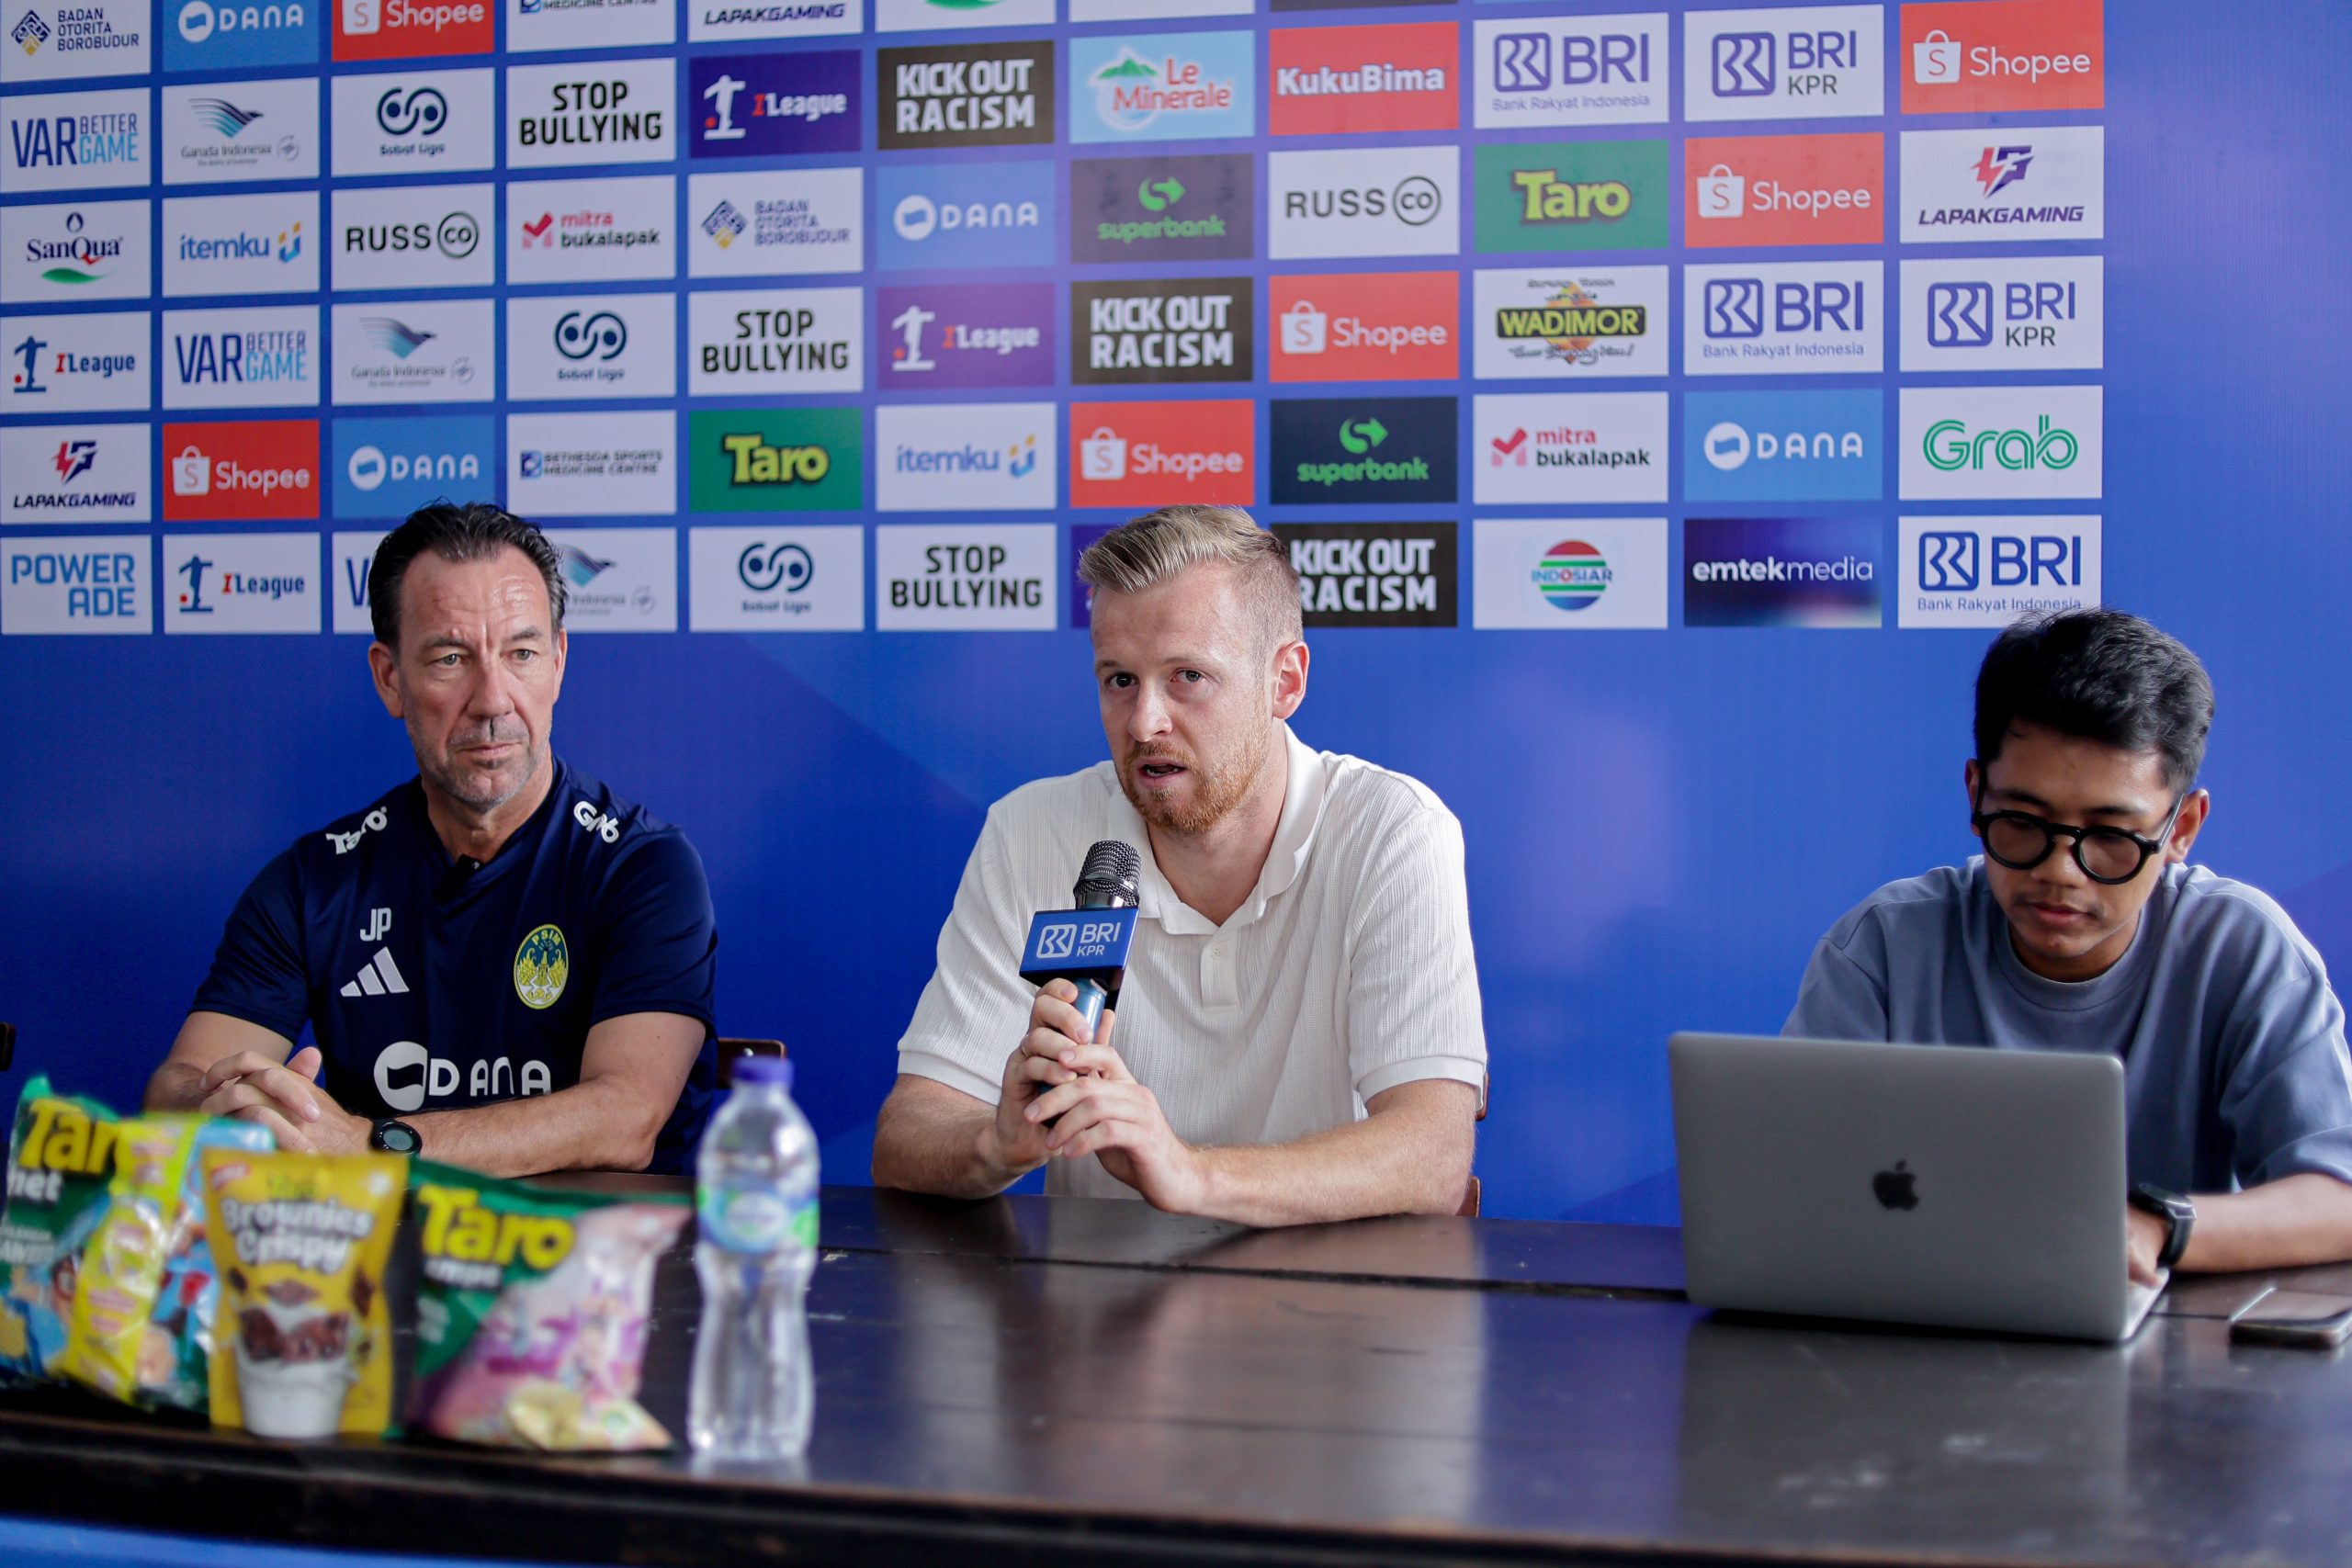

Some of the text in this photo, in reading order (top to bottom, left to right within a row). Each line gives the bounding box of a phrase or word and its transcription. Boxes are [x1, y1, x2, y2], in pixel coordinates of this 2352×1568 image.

[58, 7, 104, 24] BADAN
[58, 21, 112, 36] OTORITA
[219, 5, 304, 32] DANA
[387, 0, 485, 32] Shopee
[705, 4, 844, 26] LAPAKGAMING
[58, 33, 139, 51] BOROBUDUR
[1788, 31, 1856, 69] BRI
[1166, 60, 1198, 85] Le
[1563, 34, 1649, 85] BRI
[1970, 47, 2091, 82] Shopee
[897, 58, 1034, 97] KICK OUT
[1277, 64, 1446, 95] KukuBima
[1788, 75, 1838, 96] KPR
[554, 82, 628, 111] STOP
[1113, 80, 1231, 113] Minerale
[1492, 94, 1650, 112] Bank Rakyat Indonesia
[81, 113, 138, 135] BETTER
[520, 112, 662, 146] BULLYING
[897, 96, 1035, 134] RACISM
[11, 117, 77, 168] VAR
[80, 133, 138, 164] GAME
[755, 200, 808, 216] BADAN
[1286, 189, 1385, 218] RUSS
[1511, 169, 1631, 224] Taro
[1752, 182, 1871, 217] Shopee
[560, 209, 614, 229] mitra
[755, 214, 819, 231] OTORITA
[941, 202, 1038, 231] DANA
[1098, 215, 1225, 243] superbank
[1918, 207, 2085, 226] LAPAKGAMING
[27, 238, 119, 264] SanQua
[181, 233, 269, 260] itemku
[346, 225, 431, 253] RUSS
[560, 230, 660, 250] bukalapak
[755, 229, 850, 247] BOROBUDUR
[1091, 294, 1232, 333] KICK OUT
[1775, 282, 1862, 332] BRI
[2006, 282, 2075, 320] BRI
[736, 310, 814, 337] STOP
[1333, 318, 1447, 354] Shopee
[1500, 310, 1639, 335] WADIMOR
[246, 331, 307, 352] BETTER
[1091, 332, 1233, 368] RACISM
[1702, 343, 1864, 359] Bank Rakyat Indonesia
[2006, 327, 2056, 347] KPR
[175, 333, 243, 383] VAR
[245, 351, 308, 380] GAME
[703, 342, 849, 373] BULLYING
[1536, 428, 1596, 446] mitra
[1757, 433, 1863, 458] DANA
[1923, 414, 2078, 470] Grab
[391, 455, 480, 480] DANA
[723, 434, 830, 486] Taro
[897, 445, 999, 471] itemku
[1131, 444, 1243, 480] Shopee
[1296, 458, 1429, 486] superbank
[1536, 448, 1650, 470] bukalapak
[215, 462, 311, 497] Shopee
[13, 492, 136, 508] LAPAKGAMING
[12, 554, 135, 584] POWER
[927, 547, 1006, 573] STOP
[1288, 538, 1435, 576] KICK OUT
[1692, 557, 1872, 582] emtekmedia
[1991, 536, 2081, 586] BRI
[1532, 566, 1613, 583] INDOSIAR
[69, 588, 135, 616] ADE
[892, 581, 1041, 609] BULLYING
[1299, 575, 1436, 612] RACISM
[1917, 597, 2081, 613] Bank Rakyat Indonesia
[360, 908, 391, 941] JP
[532, 930, 560, 945] PSIM
[1080, 922, 1121, 943] BRI
[1077, 945, 1105, 956] KPR
[429, 1056, 551, 1097] DANA
[18, 1098, 118, 1175] Tar
[220, 1196, 372, 1240] Brownies
[415, 1183, 577, 1270] Taro
